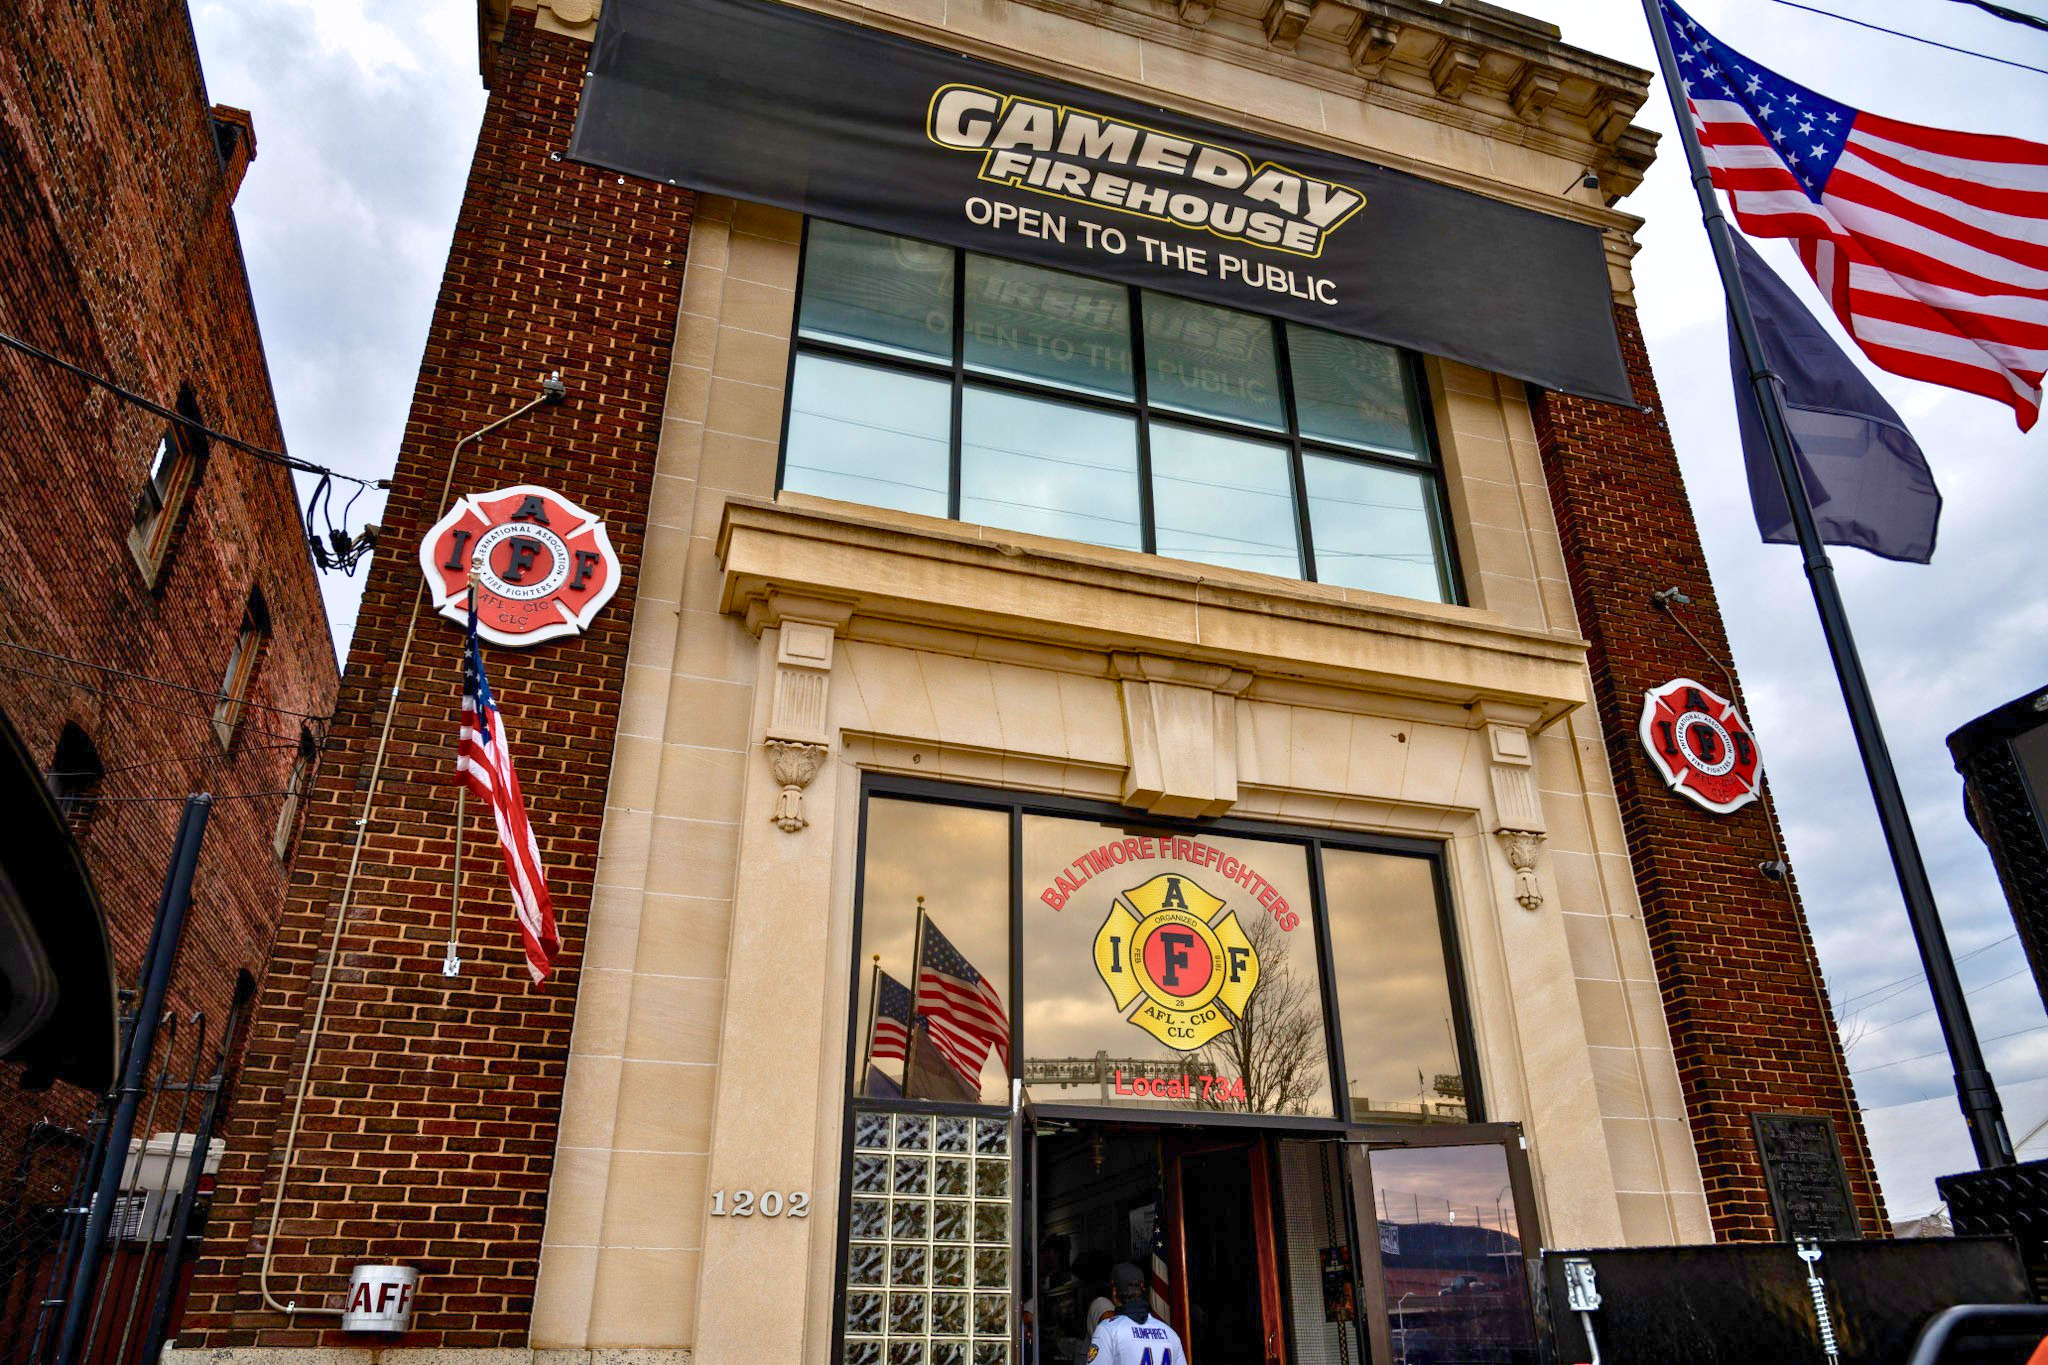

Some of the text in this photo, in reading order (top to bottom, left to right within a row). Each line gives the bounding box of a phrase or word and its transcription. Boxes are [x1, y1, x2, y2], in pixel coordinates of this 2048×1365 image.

[934, 88, 1360, 229] GAMEDAY
[988, 150, 1323, 253] FIREHOUSE
[964, 197, 1339, 306] OPEN TO THE PUBLIC
[511, 495, 550, 525] A
[502, 536, 541, 582] F
[536, 529, 567, 577] ASSOCIATION
[485, 576, 553, 597] FIRE FIGHTERS
[569, 550, 600, 591] F
[498, 613, 529, 626] CLC
[1678, 714, 1733, 754] INTERNATIONAL ASSOCIATION
[1040, 835, 1301, 932] BALTIMORE FIREFIGHTERS
[1162, 878, 1189, 910] A
[1155, 914, 1198, 928] ORGANIZED
[1134, 948, 1142, 964] FEB
[1160, 932, 1194, 987] F
[1228, 947, 1250, 983] F
[1144, 1006, 1175, 1025] AFL
[1190, 1010, 1216, 1026] CIO
[1167, 1027, 1195, 1039] CLC
[1115, 1070, 1248, 1103] Local 734
[711, 1190, 810, 1218] 1202
[1131, 1326, 1169, 1340] HUMPHREY
